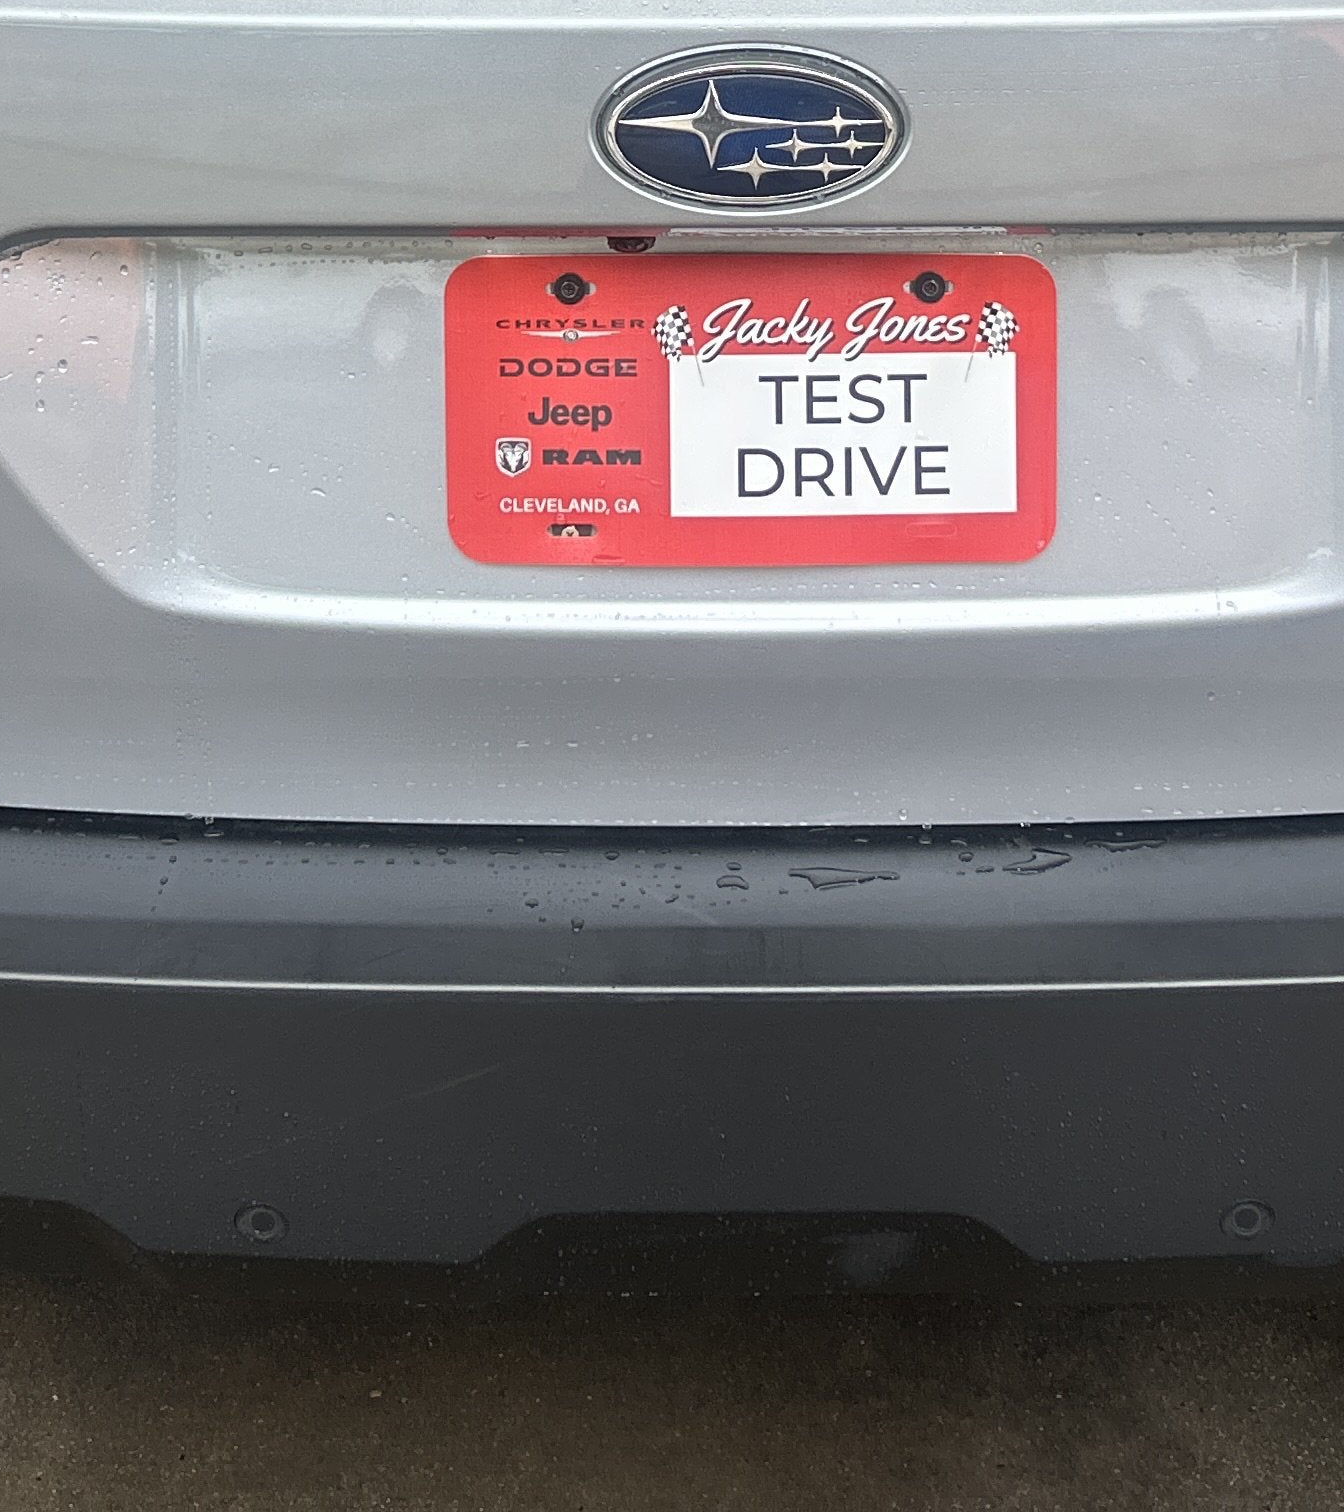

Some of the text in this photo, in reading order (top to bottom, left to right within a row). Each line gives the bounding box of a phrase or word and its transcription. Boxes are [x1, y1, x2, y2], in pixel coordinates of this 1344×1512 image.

[496, 318, 645, 329] CHRYSLER
[700, 296, 972, 363] Jacky Jones
[499, 358, 638, 377] DODGE
[758, 373, 929, 425] TEST
[528, 397, 613, 431] Jeep
[542, 448, 641, 466] RAM
[737, 444, 951, 498] DRIVE
[499, 497, 640, 516] CLEVELAND, GA
